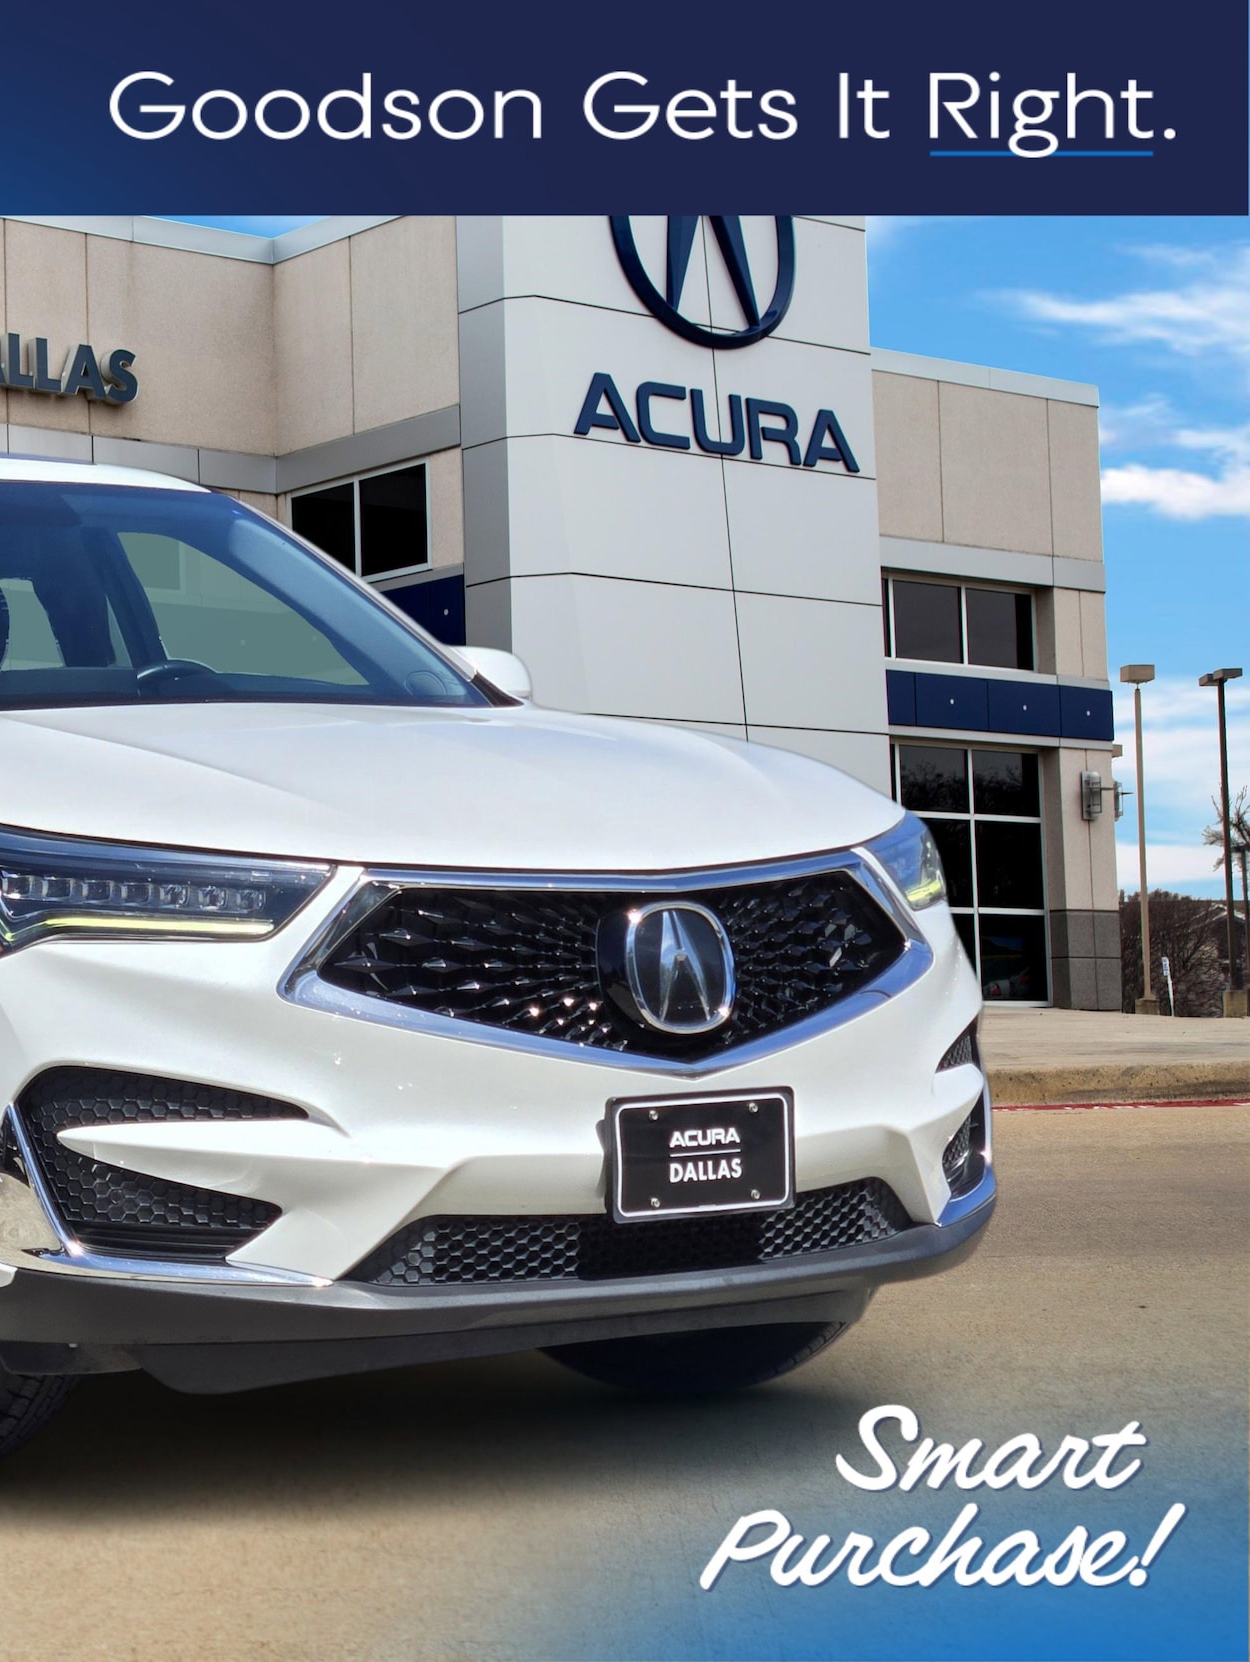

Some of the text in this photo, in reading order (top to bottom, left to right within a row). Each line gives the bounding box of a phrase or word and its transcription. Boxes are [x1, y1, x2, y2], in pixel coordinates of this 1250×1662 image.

[574, 371, 860, 473] ACURA
[669, 1127, 740, 1148] ACURA
[669, 1158, 742, 1183] DALLAS
